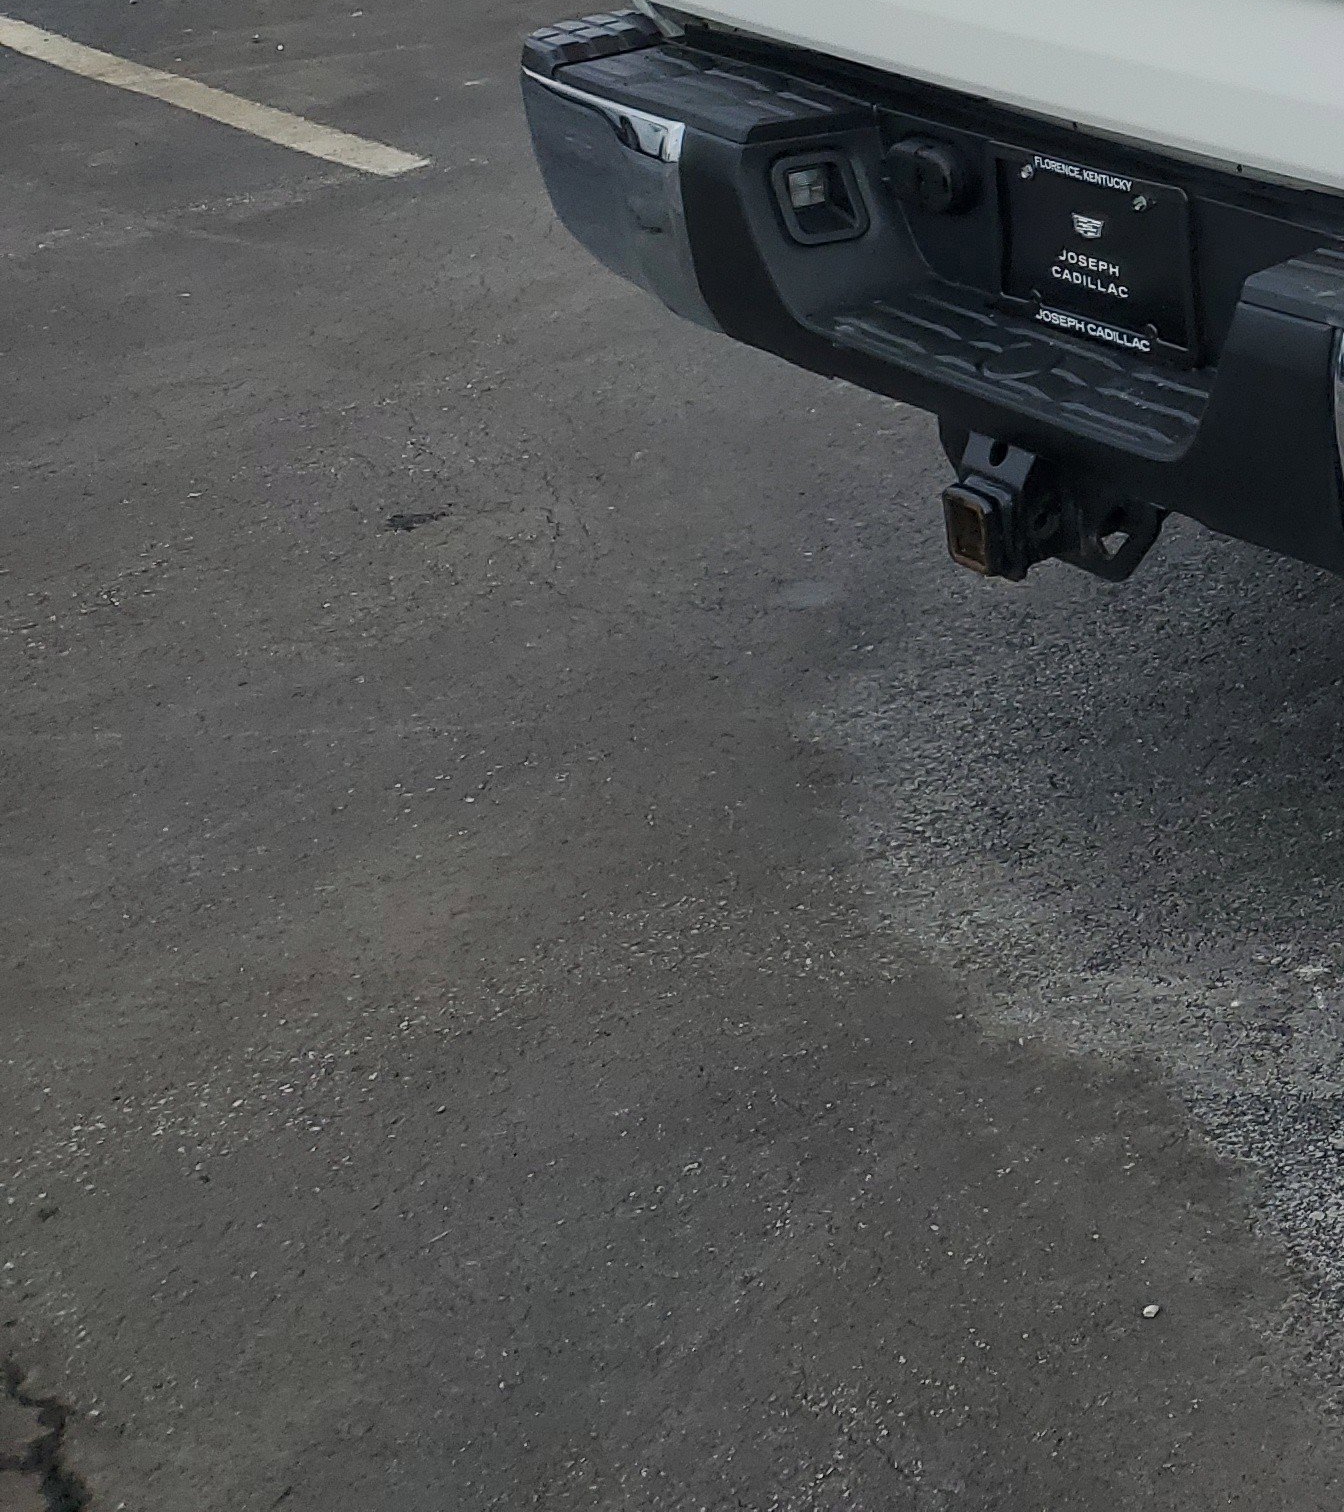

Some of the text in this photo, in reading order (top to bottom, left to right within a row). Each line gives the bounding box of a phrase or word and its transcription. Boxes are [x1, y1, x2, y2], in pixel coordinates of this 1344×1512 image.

[1082, 168, 1133, 192] KENTUCKY
[1058, 249, 1120, 277] JOSEPH
[1052, 266, 1129, 298] CADILLAC
[1035, 308, 1150, 352] JOSEPH CADILLAC
